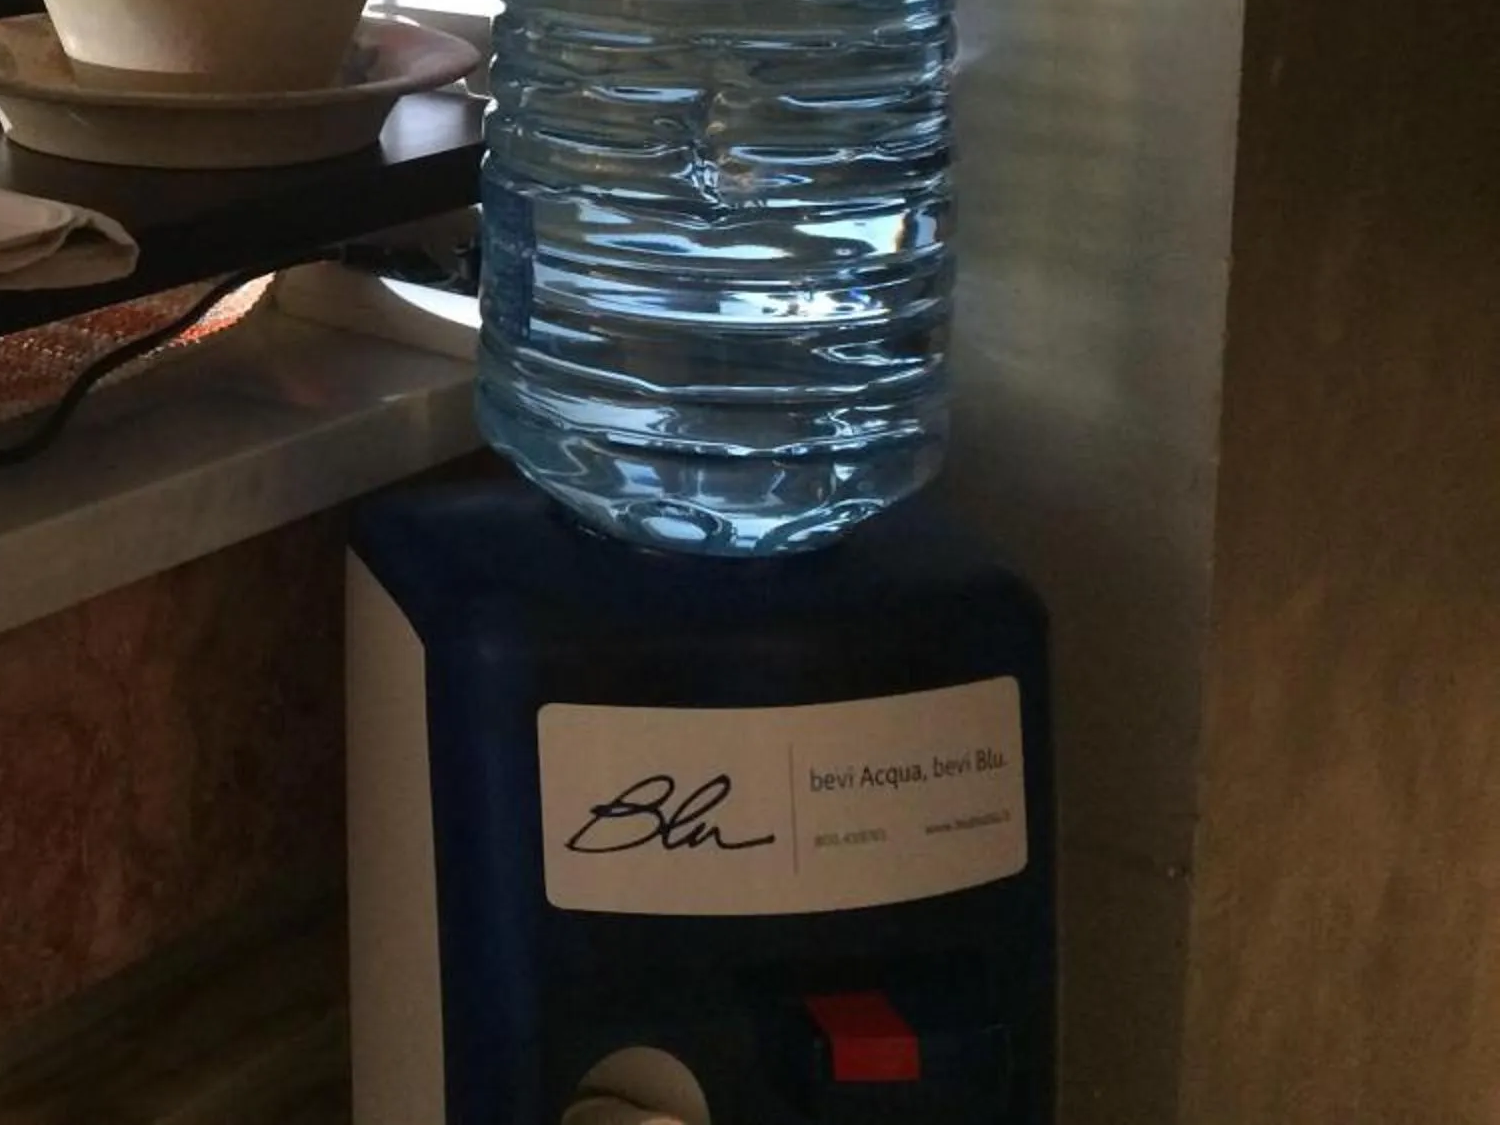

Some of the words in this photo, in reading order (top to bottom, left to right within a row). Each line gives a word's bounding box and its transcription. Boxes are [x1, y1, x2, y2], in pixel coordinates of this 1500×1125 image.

[808, 766, 854, 793] bevi
[859, 764, 928, 790] Acqua,
[931, 750, 972, 778] bevi
